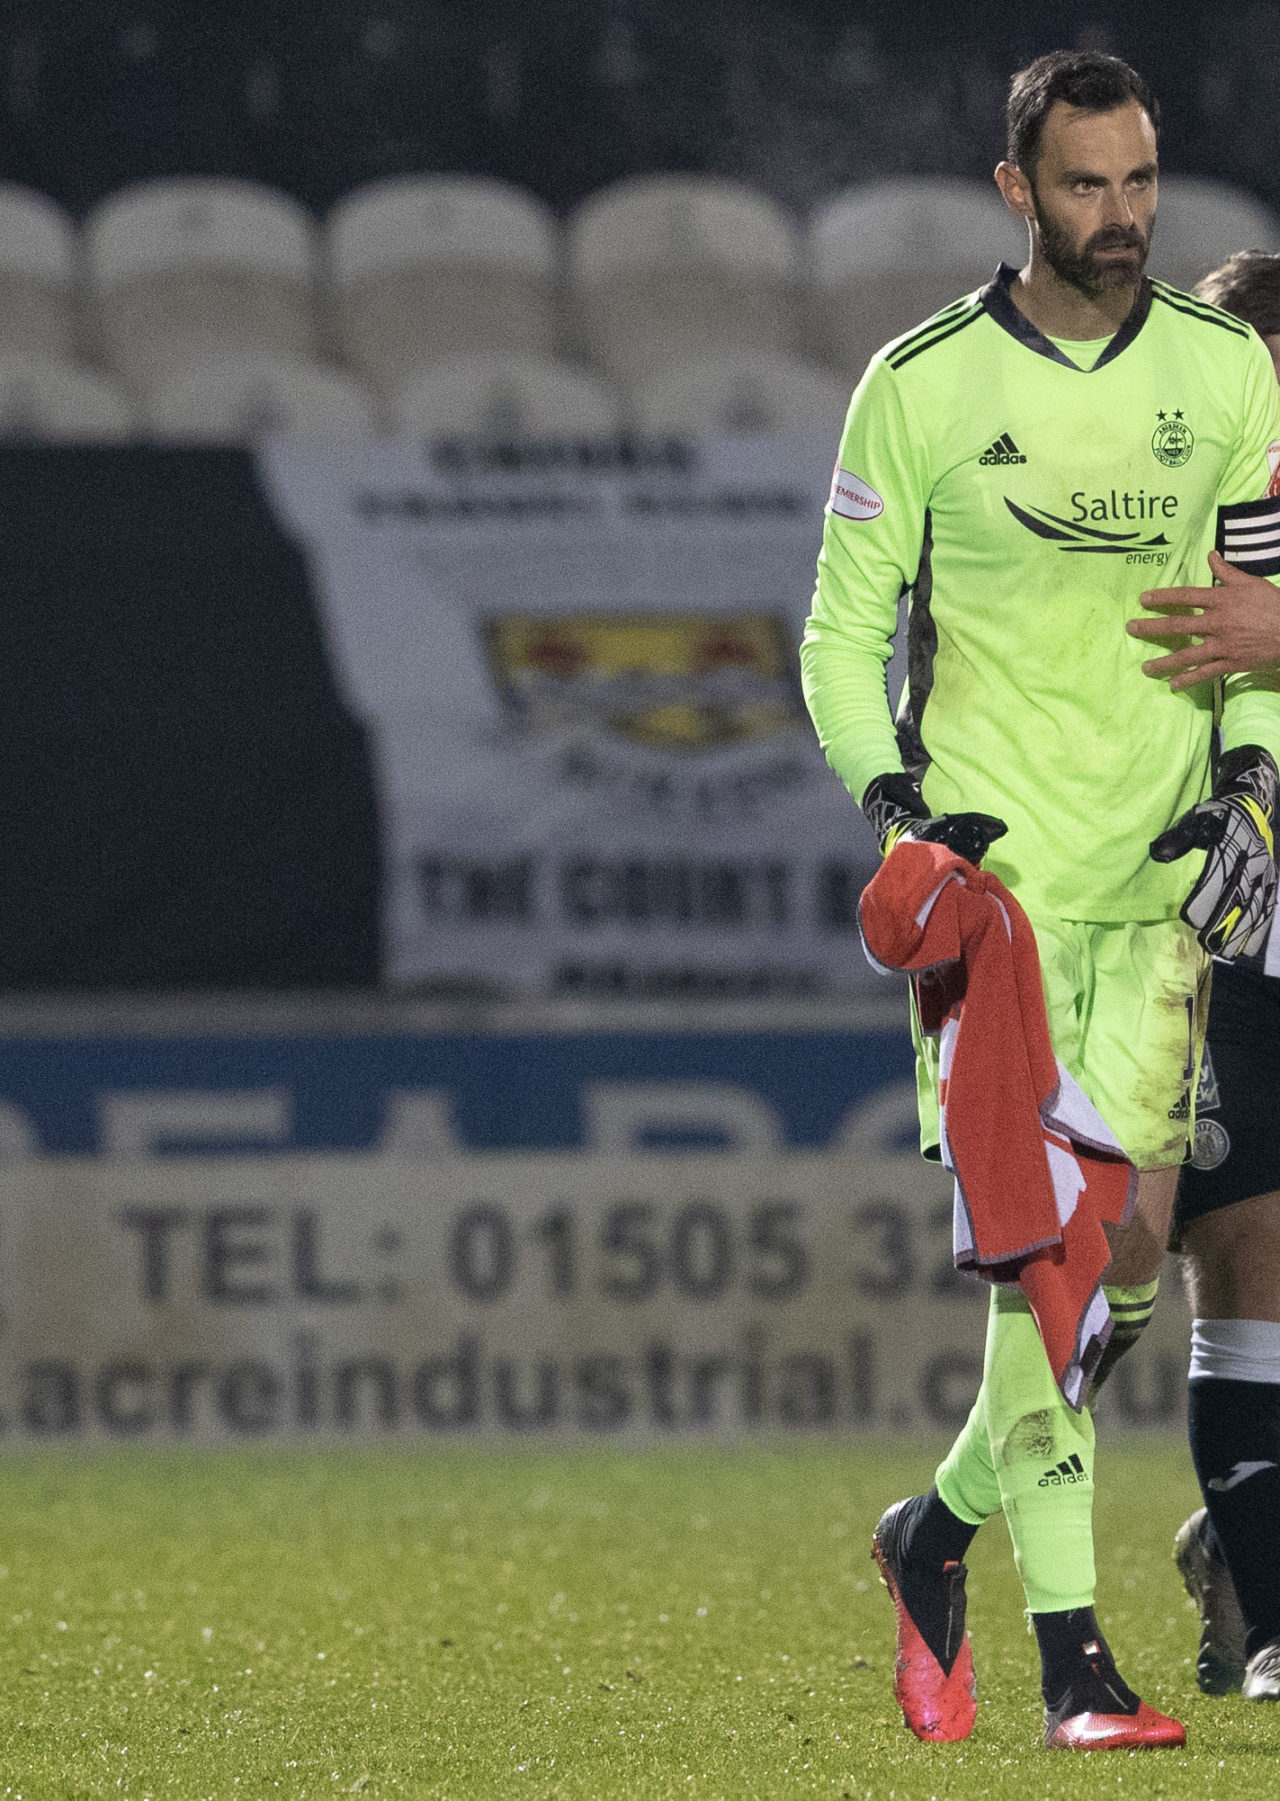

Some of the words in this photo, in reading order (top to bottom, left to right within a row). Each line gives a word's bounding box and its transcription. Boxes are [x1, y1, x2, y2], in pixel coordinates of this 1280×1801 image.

[979, 453, 1027, 466] adidas
[1071, 490, 1179, 522] Saltire
[1126, 552, 1171, 566] energy
[120, 1204, 400, 1303] TEL:
[447, 1202, 808, 1302] 01505
[1038, 1473, 1089, 1488] adidas
